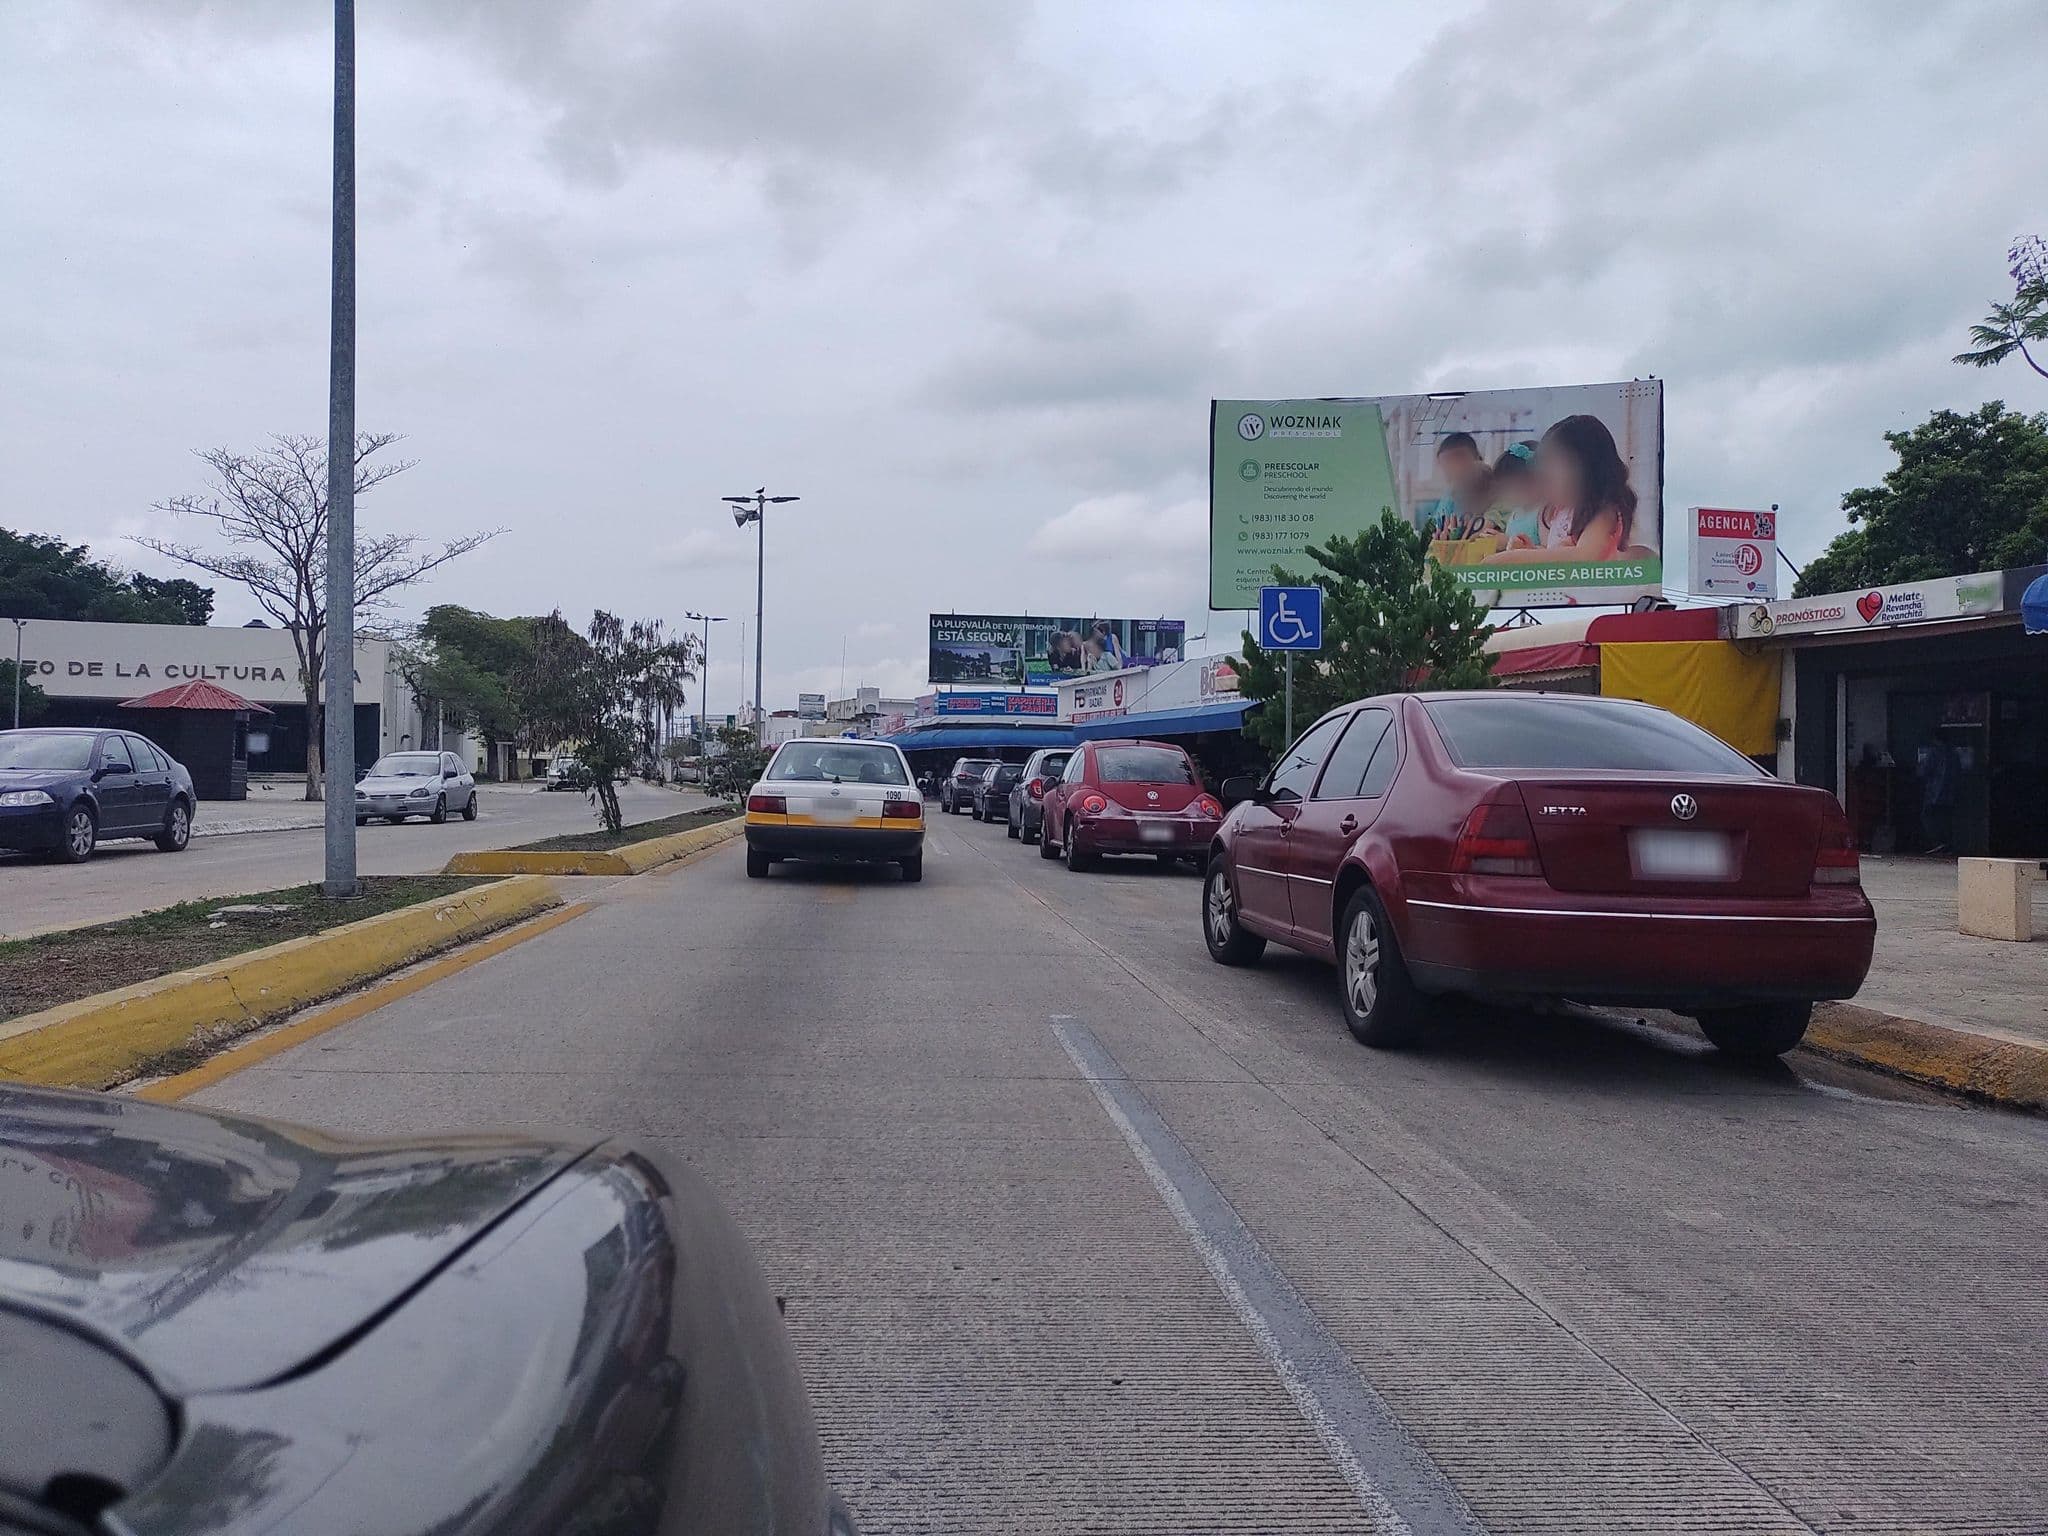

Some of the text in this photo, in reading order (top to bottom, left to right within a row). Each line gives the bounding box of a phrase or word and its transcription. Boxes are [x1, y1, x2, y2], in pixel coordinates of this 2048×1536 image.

[1270, 416, 1342, 428] WOZNIAK
[1264, 462, 1320, 471] PREESCOLAR
[1264, 471, 1309, 479] PRESCHOOL
[1251, 514, 1315, 523] (983) 118 30 08
[1699, 515, 1751, 531] AGENCIA
[1252, 532, 1273, 540] (983)
[1275, 532, 1288, 540] 177
[1237, 546, 1305, 555] www.wozniak.m
[1453, 565, 1644, 584] NSCRIPCIONES ABIERTAS
[1888, 592, 1920, 604] Melate
[1886, 600, 1922, 613] Revancha
[1776, 606, 1841, 624] PRONÓSTICOS
[1881, 609, 1923, 621] Revanchita
[932, 619, 943, 628] LA
[944, 619, 991, 629] PLUSVALÍA
[1013, 624, 1057, 632] PATRIMONIO
[937, 629, 1013, 643] ESTÁ SEGURA
[22, 659, 55, 675] EO
[68, 661, 104, 677] DE
[116, 662, 151, 678] LA
[164, 664, 286, 682] CULTURA
[885, 790, 902, 800] 1090
[1539, 805, 1588, 816] JETTA
